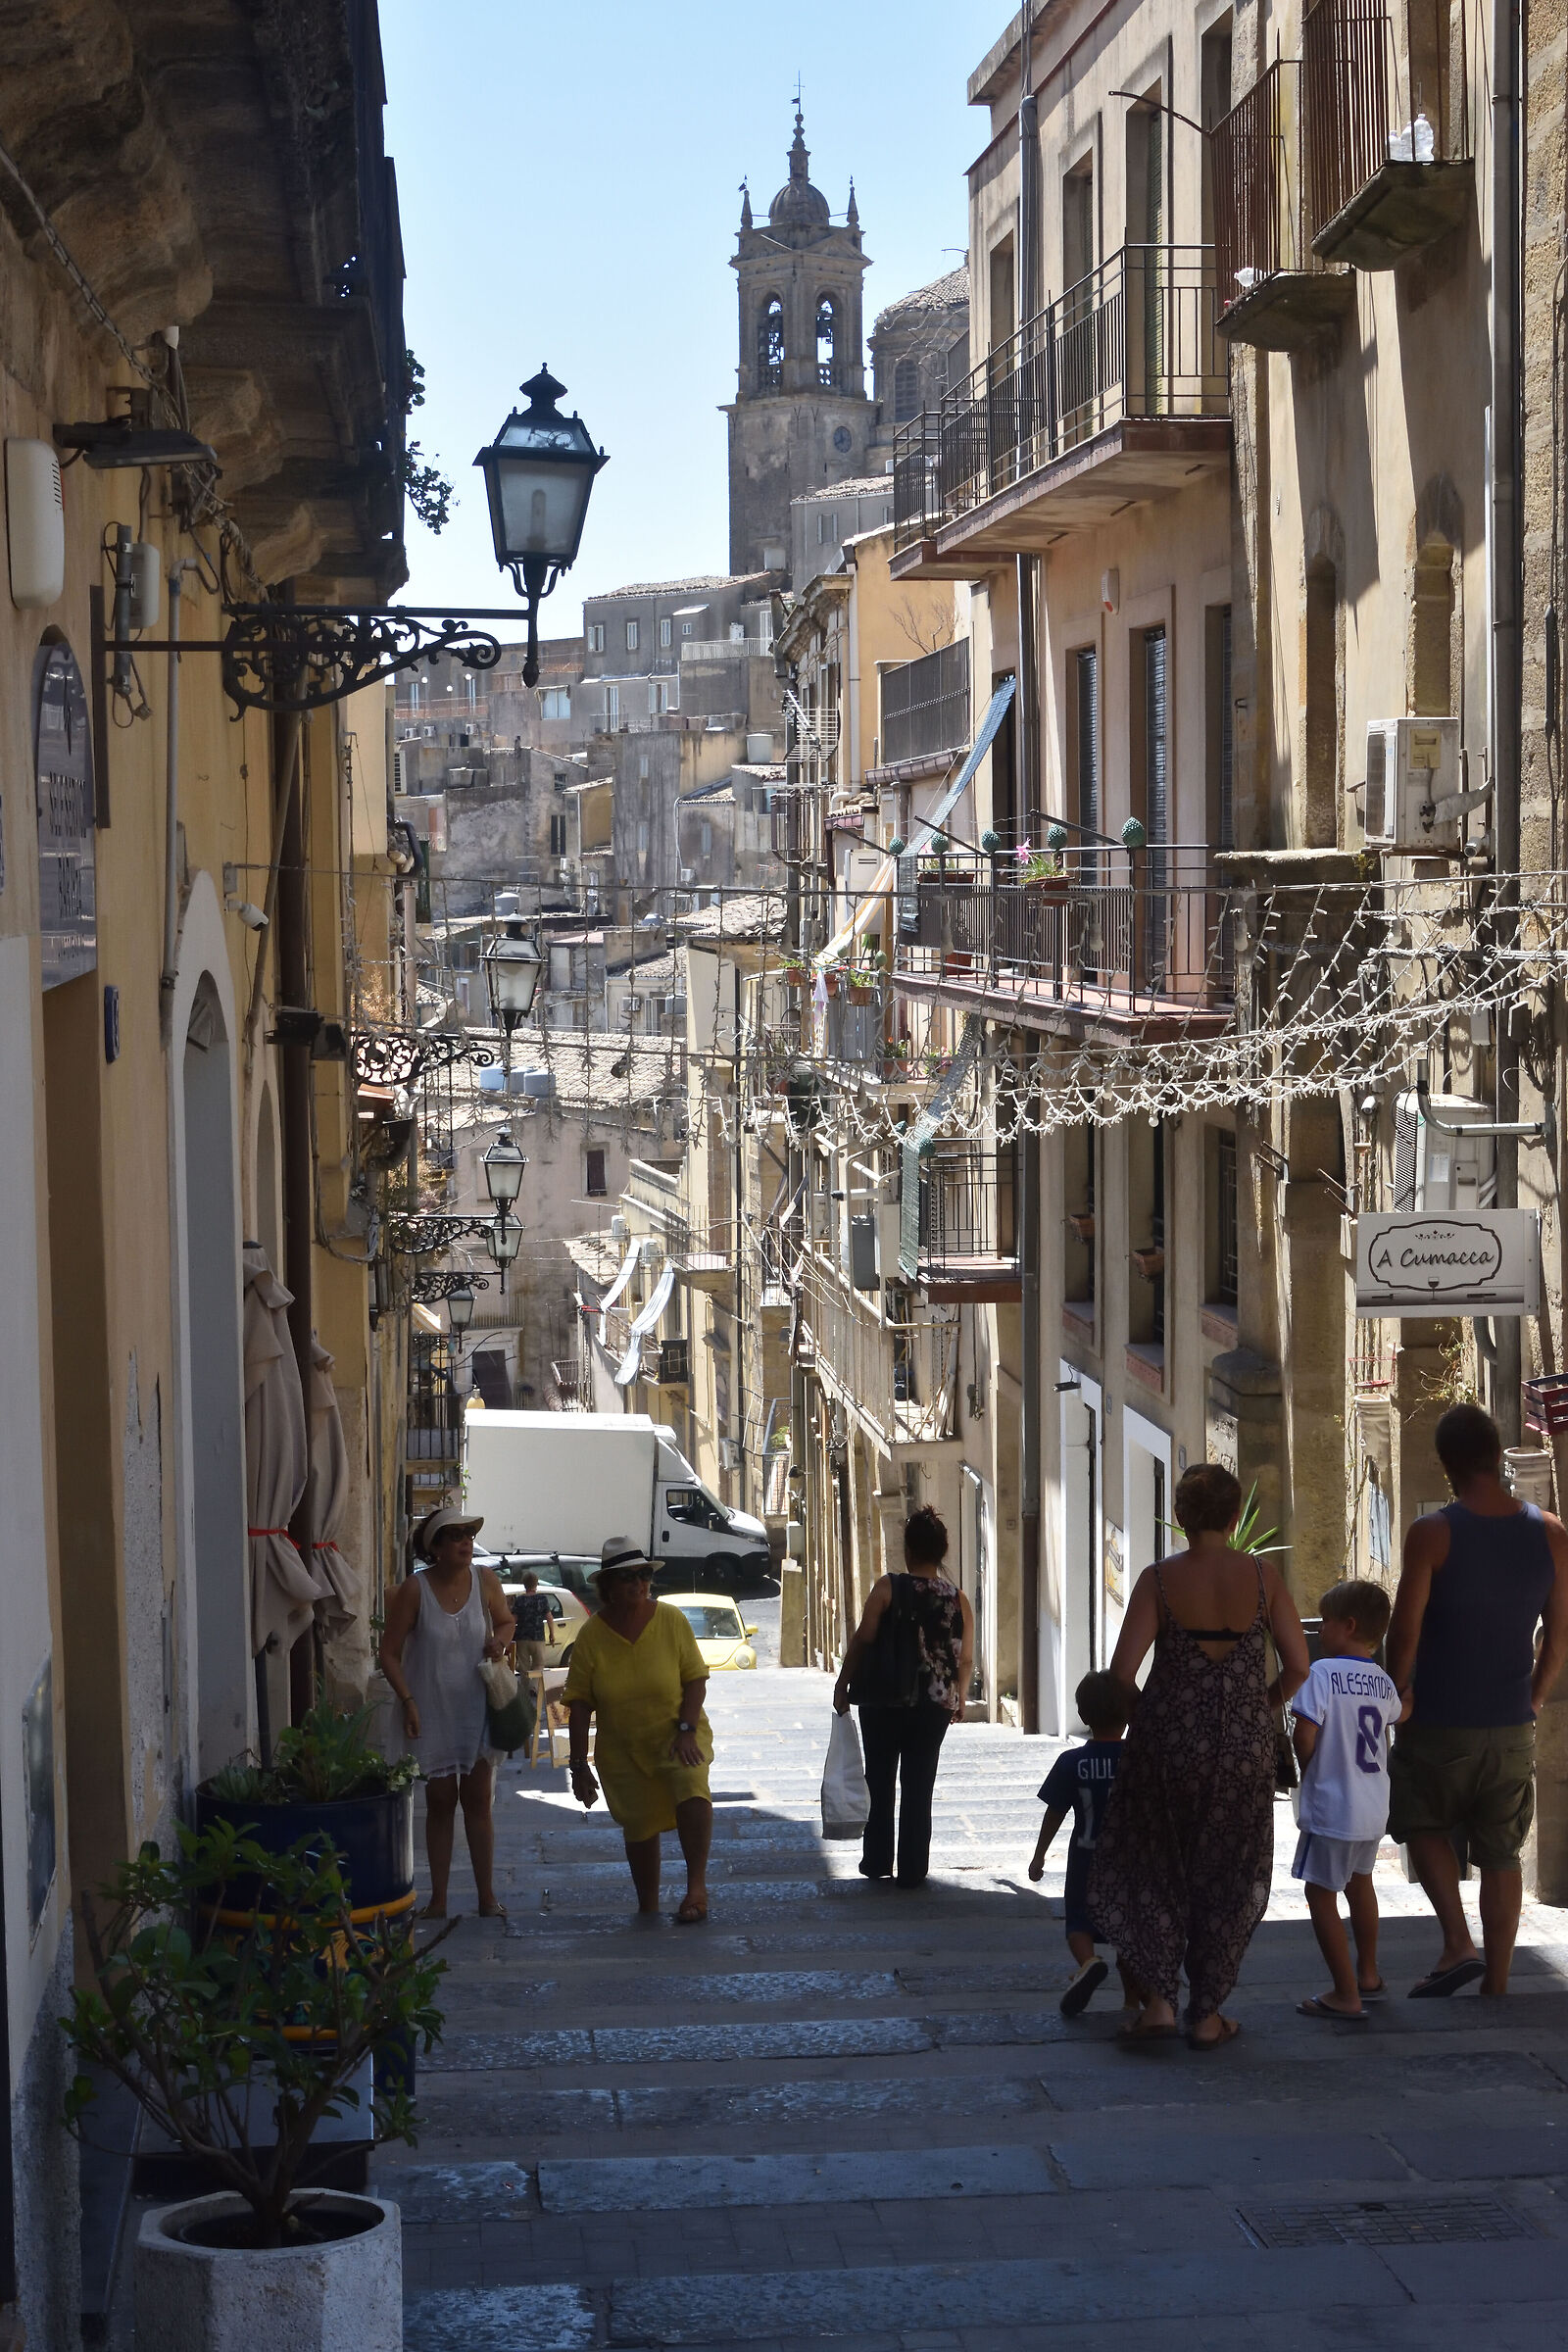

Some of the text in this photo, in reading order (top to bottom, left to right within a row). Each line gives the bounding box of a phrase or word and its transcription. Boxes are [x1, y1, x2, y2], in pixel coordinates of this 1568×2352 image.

[1376, 1248, 1495, 1269] A Cumacca
[1355, 1705, 1383, 1773] 8
[1077, 1757, 1121, 1780] GIUL
